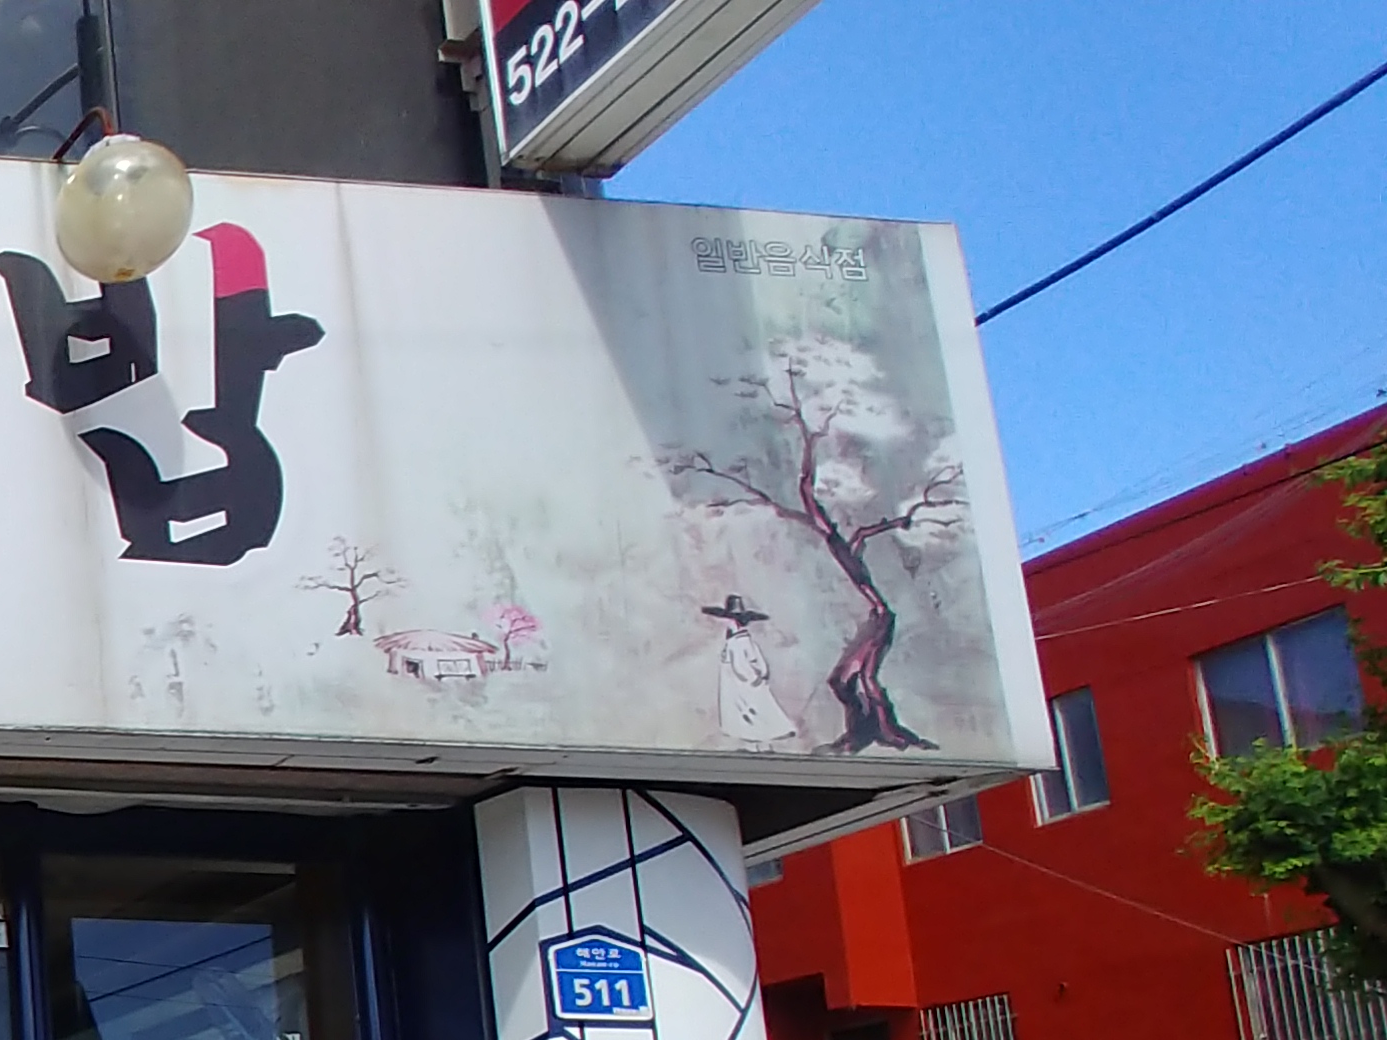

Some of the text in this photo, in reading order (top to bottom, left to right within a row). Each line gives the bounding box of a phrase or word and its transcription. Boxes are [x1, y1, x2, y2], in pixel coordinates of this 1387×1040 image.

[506, 0, 631, 105] 522-
[691, 236, 869, 281] 일반음식점
[573, 978, 631, 1007] 511
